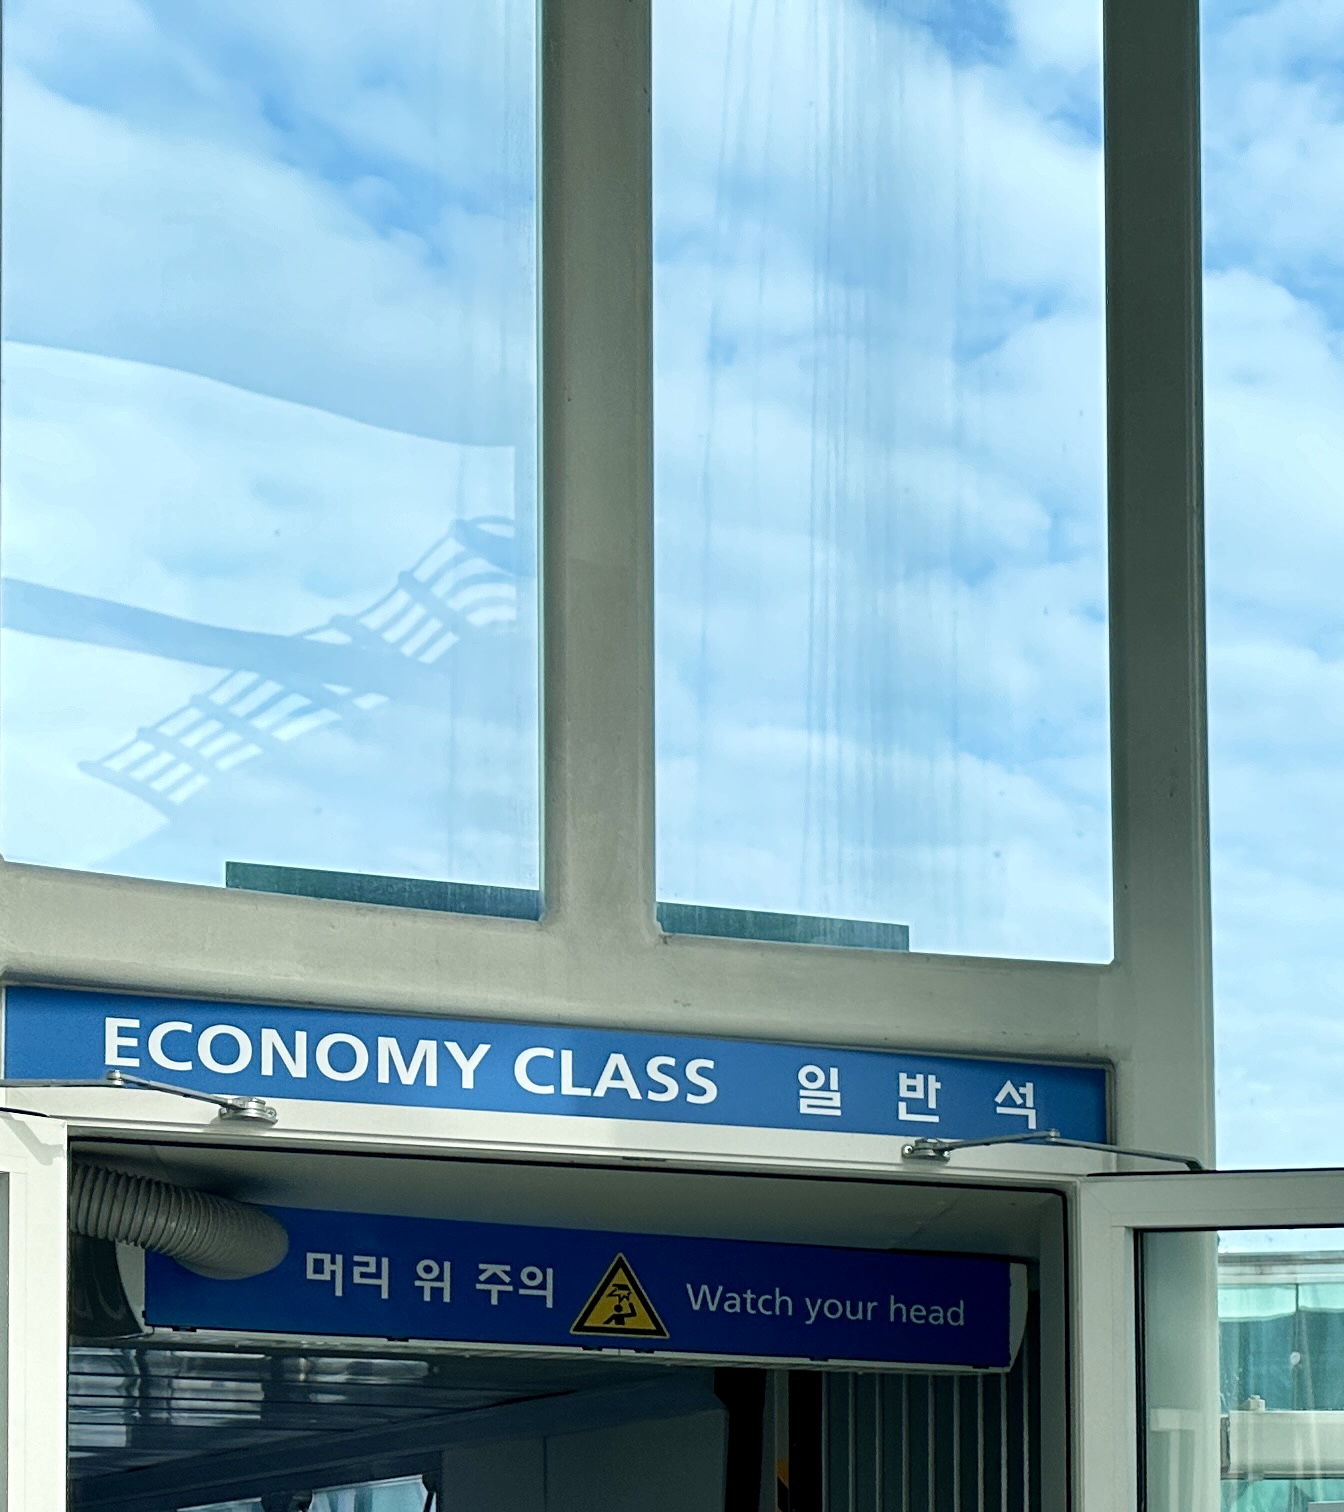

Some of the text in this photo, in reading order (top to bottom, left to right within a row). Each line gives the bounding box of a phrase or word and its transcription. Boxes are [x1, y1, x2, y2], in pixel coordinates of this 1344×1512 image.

[104, 1016, 720, 1105] ECONOMY CLASS
[305, 1251, 554, 1309] 머리 위 주의
[686, 1282, 966, 1327] Watch your head
